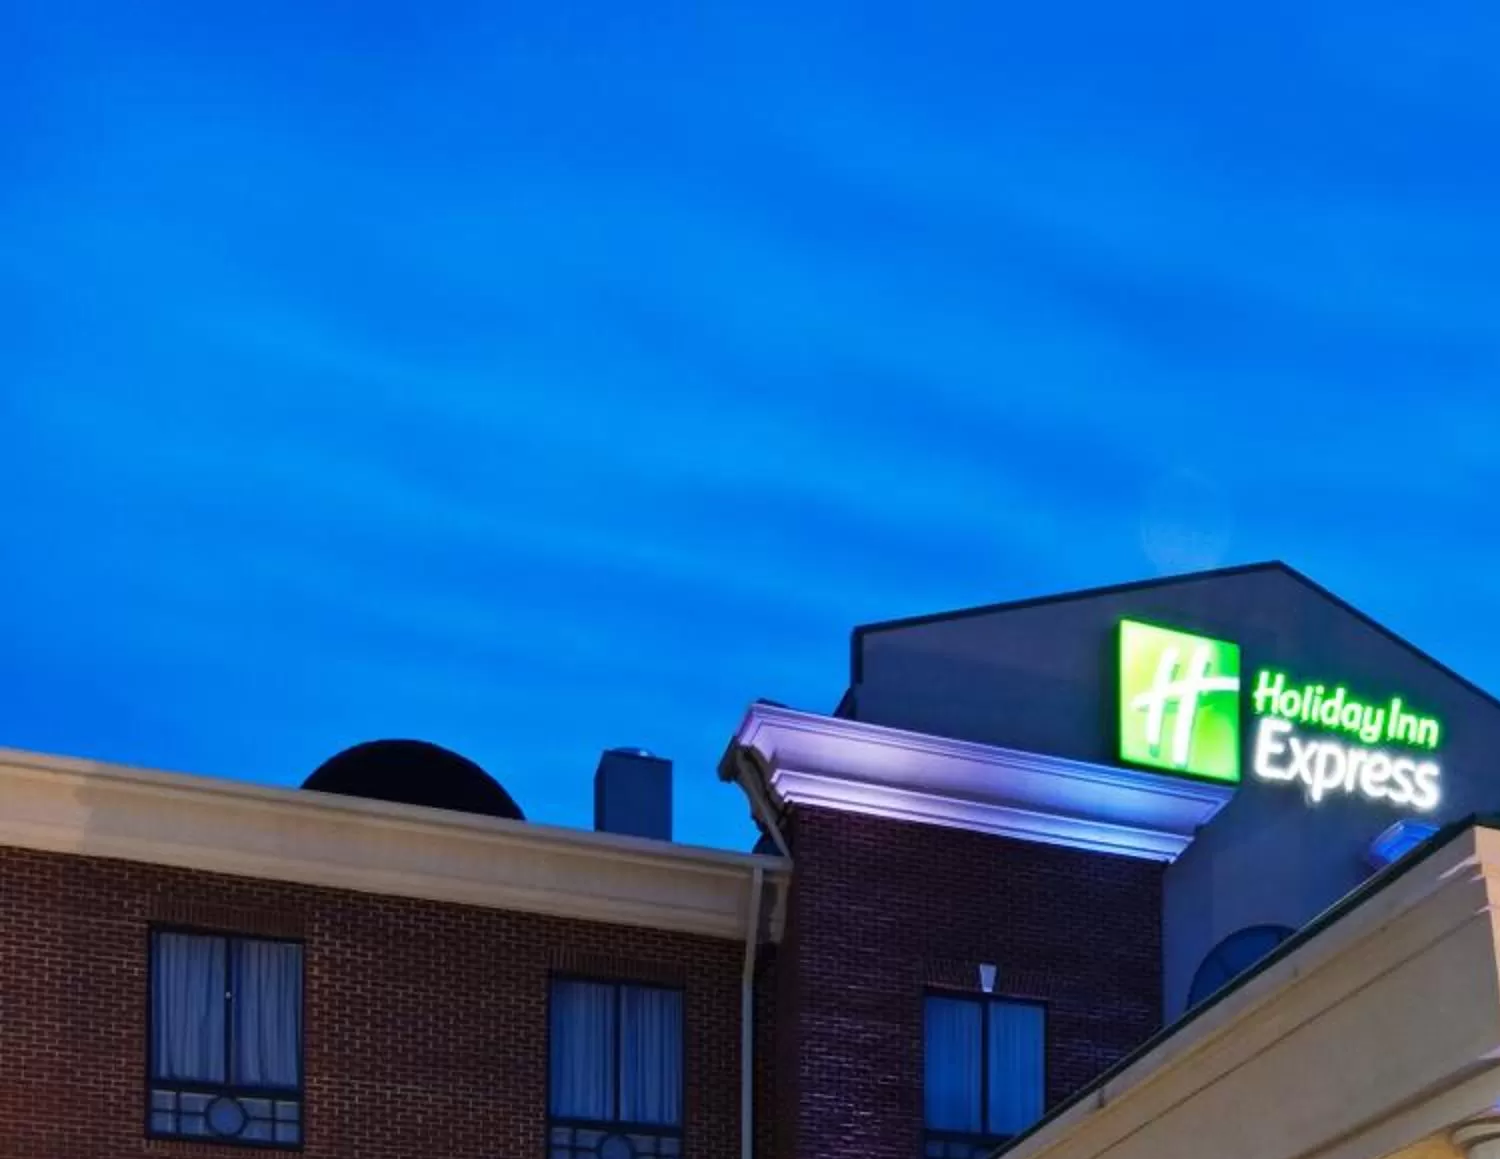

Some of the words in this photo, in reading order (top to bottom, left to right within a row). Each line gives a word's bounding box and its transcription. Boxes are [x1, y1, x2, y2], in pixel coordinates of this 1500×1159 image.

[1254, 670, 1383, 743] Holiday
[1387, 698, 1440, 749] Inn
[1254, 718, 1441, 809] Express
